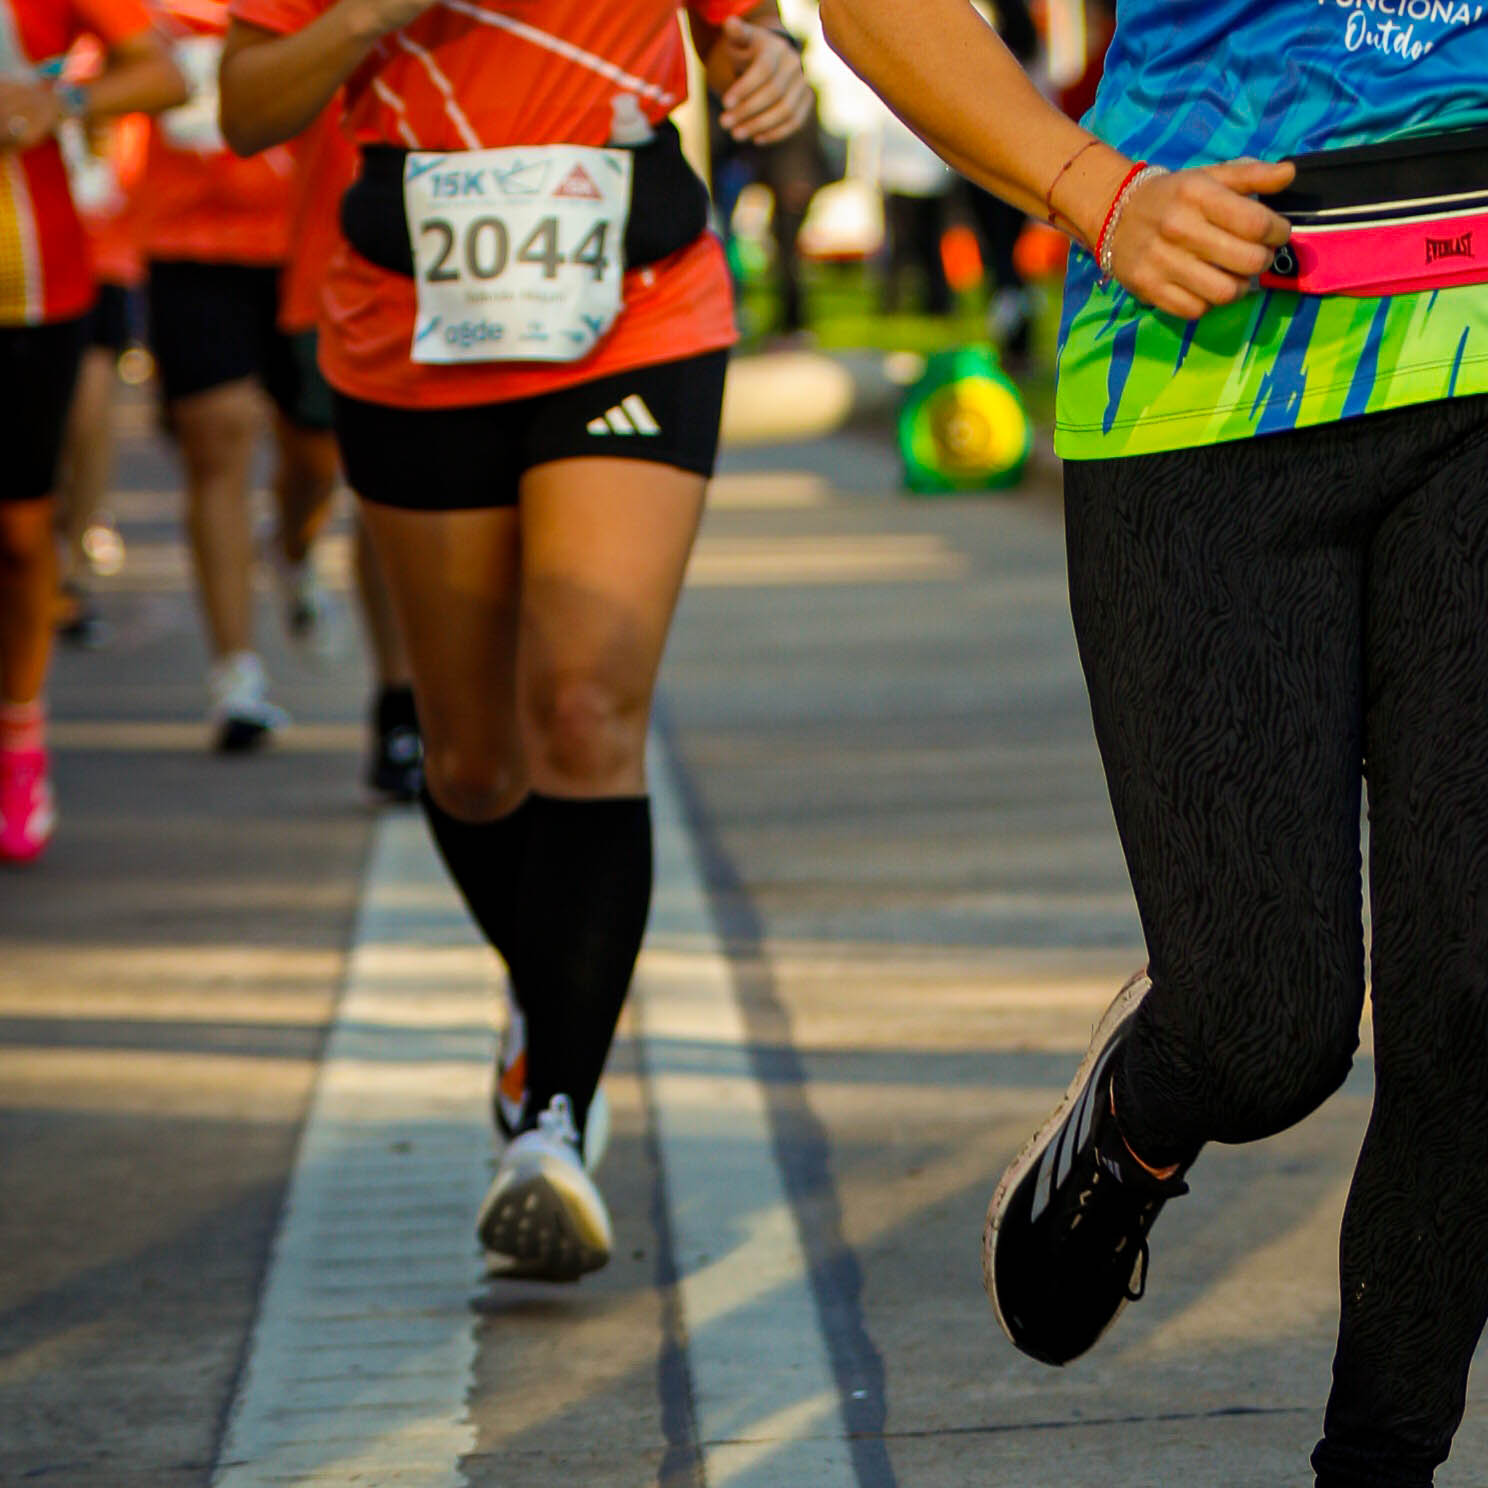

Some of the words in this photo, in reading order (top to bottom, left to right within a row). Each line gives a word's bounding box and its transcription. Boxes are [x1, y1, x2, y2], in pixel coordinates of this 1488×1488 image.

[430, 168, 484, 198] 15K
[420, 213, 612, 284] 2044
[1425, 231, 1474, 264] EVERLAST
